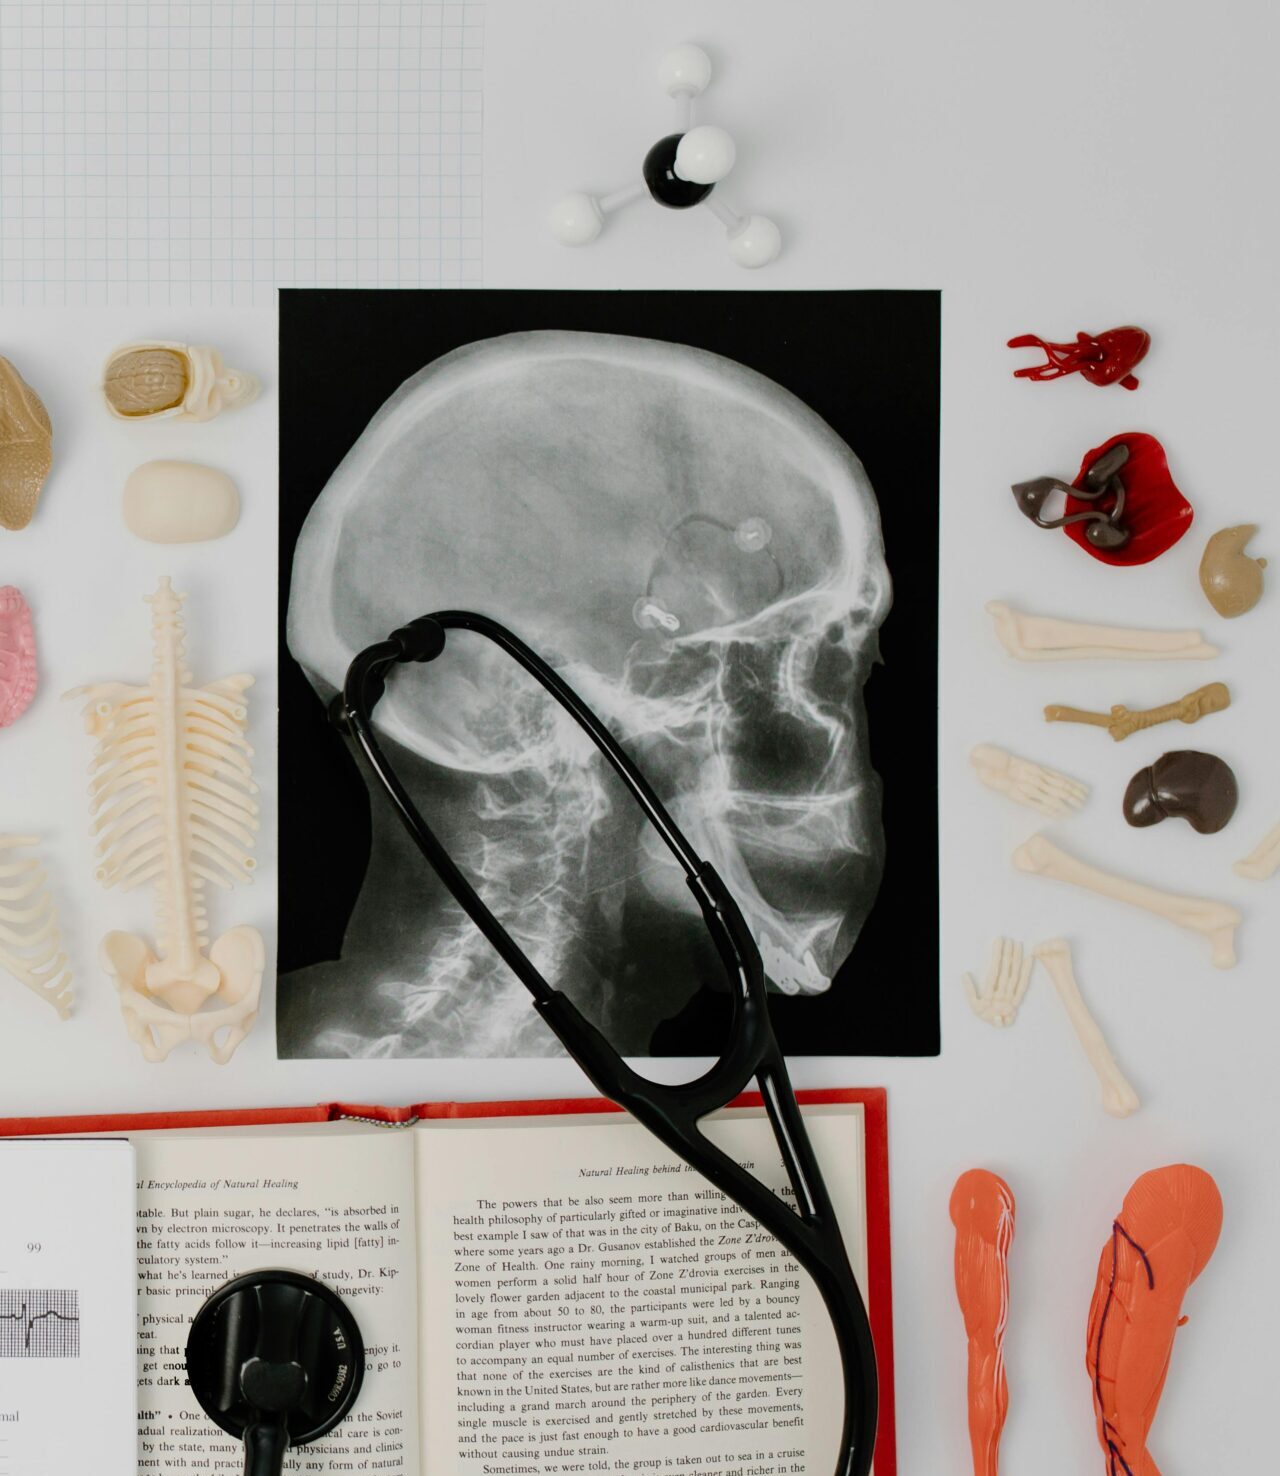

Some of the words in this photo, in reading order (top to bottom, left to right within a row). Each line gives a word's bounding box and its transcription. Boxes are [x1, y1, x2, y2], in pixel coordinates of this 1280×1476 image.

[578, 1167, 613, 1178] Natural
[615, 1165, 650, 1177] Healing
[652, 1163, 682, 1174] behind
[147, 1179, 207, 1191] Encyclopedia
[210, 1179, 222, 1191] of
[223, 1179, 259, 1189] Natural
[262, 1179, 299, 1190] Healing
[476, 1199, 497, 1209] The
[502, 1200, 538, 1211] powers
[543, 1197, 563, 1208] that
[568, 1196, 580, 1207] be
[584, 1195, 604, 1206] also
[608, 1196, 633, 1205] seem
[638, 1194, 663, 1203] more
[667, 1191, 689, 1202] than
[693, 1189, 726, 1201] willing
[171, 1208, 189, 1218] But
[194, 1207, 219, 1220] plain
[223, 1210, 255, 1220] sugar,
[259, 1207, 271, 1217] he
[275, 1207, 320, 1218] declares,
[343, 1205, 387, 1216] absorbed
[390, 1206, 399, 1214] in
[151, 1223, 163, 1236] by
[167, 1223, 208, 1234] electron
[211, 1223, 272, 1236] microscopy.
[277, 1223, 285, 1233] It
[289, 1224, 341, 1235] penetrates
[344, 1222, 361, 1232] the
[363, 1220, 388, 1231] walls
[390, 1218, 401, 1230] of
[27, 1243, 42, 1253] 99
[455, 1280, 491, 1288] women
[497, 1276, 537, 1290] perform
[542, 1278, 549, 1286] a
[553, 1274, 577, 1286] solid
[582, 1273, 603, 1284] half
[606, 1273, 630, 1283] hour
[634, 1270, 646, 1281] of
[649, 1270, 674, 1281] Zone
[723, 1265, 765, 1276] exercises
[770, 1263, 779, 1273] in
[784, 1262, 799, 1272] the
[458, 1448, 498, 1459] without
[501, 1448, 540, 1460] causing
[544, 1447, 575, 1457] undue
[578, 1445, 609, 1456] strain.
